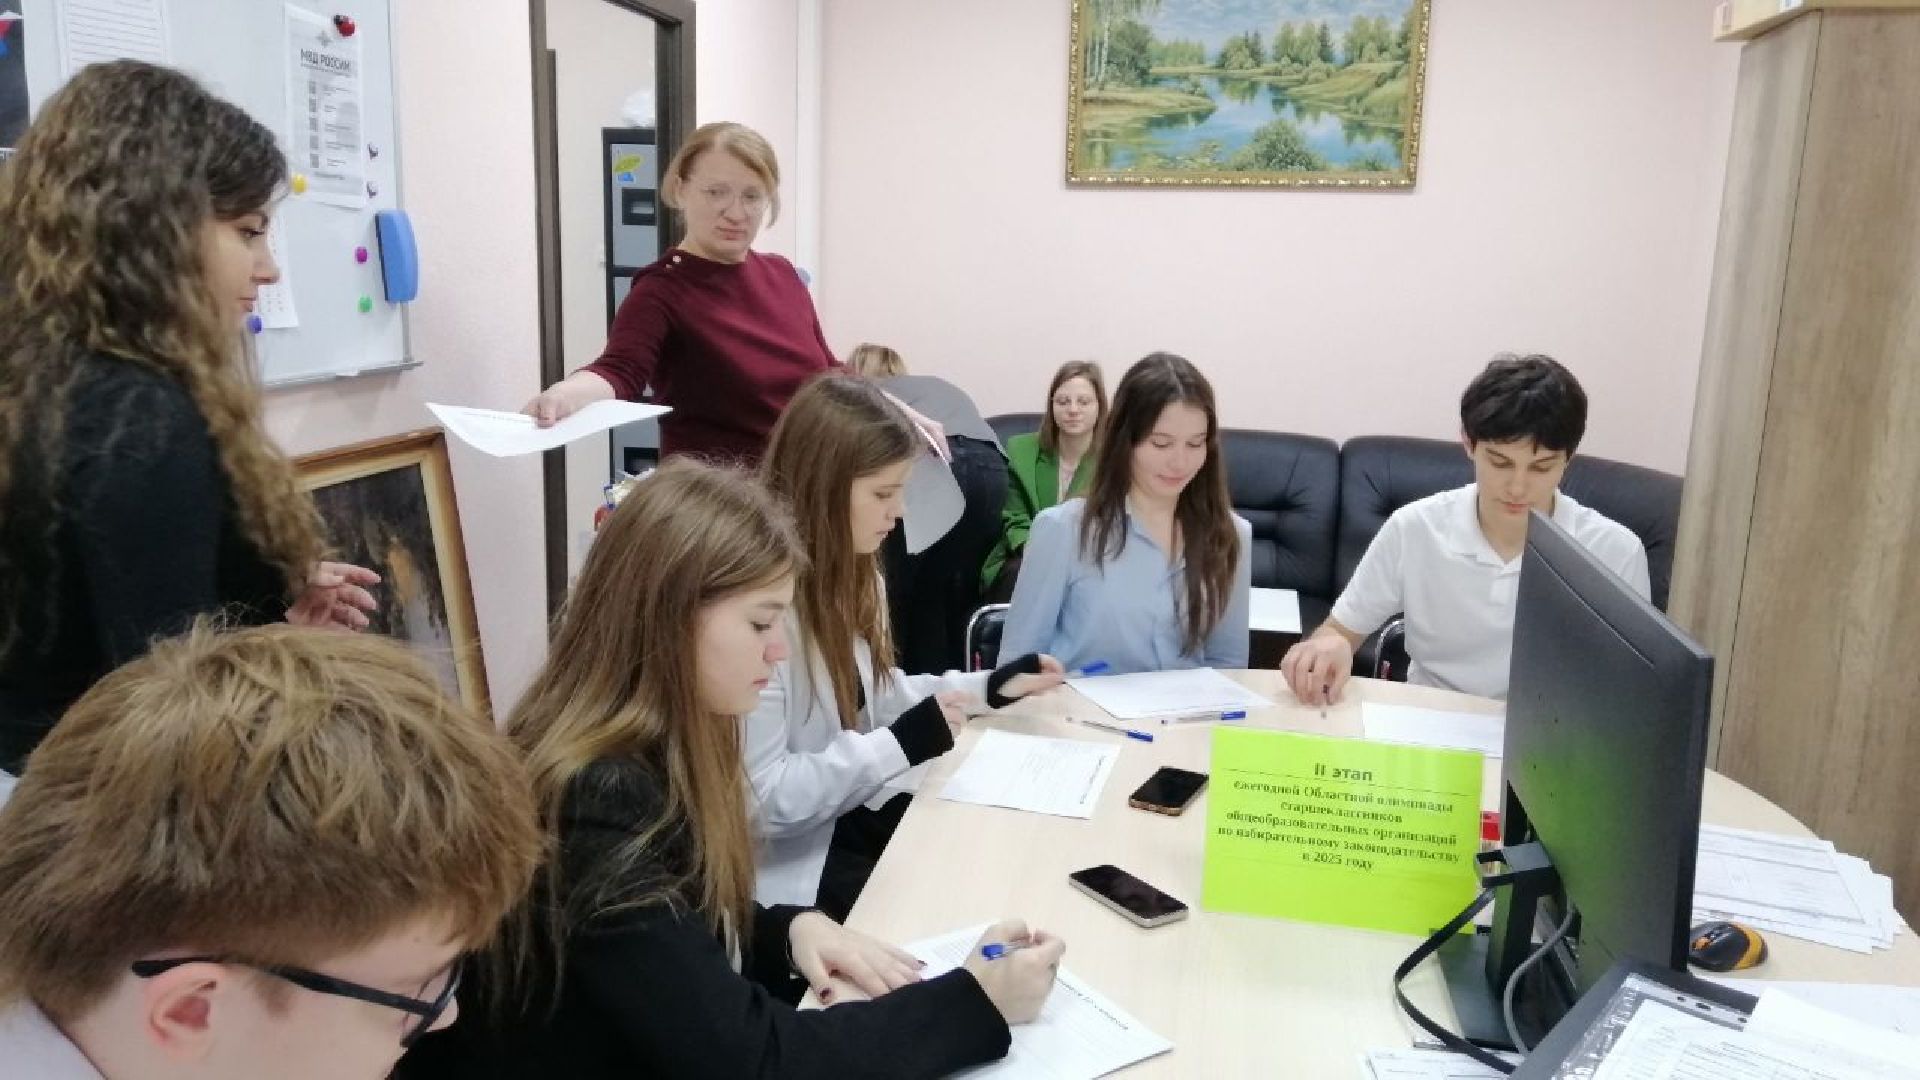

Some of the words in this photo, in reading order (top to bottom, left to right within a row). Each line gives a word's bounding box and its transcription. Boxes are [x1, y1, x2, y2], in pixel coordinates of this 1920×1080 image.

[1332, 767, 1373, 781] этап
[1233, 780, 1301, 796] ежегодной
[1304, 786, 1374, 803] Областной
[1377, 797, 1454, 814] олимпиады
[1280, 801, 1403, 823] старшеклассников
[1226, 810, 1369, 837] общеобразовательных
[1373, 828, 1458, 847] организаций
[1217, 827, 1234, 836] по
[1236, 828, 1340, 850] избирательному
[1344, 840, 1460, 864] законодательству
[1302, 852, 1311, 862] в
[1313, 851, 1343, 865] 2025
[1345, 857, 1373, 871] году
